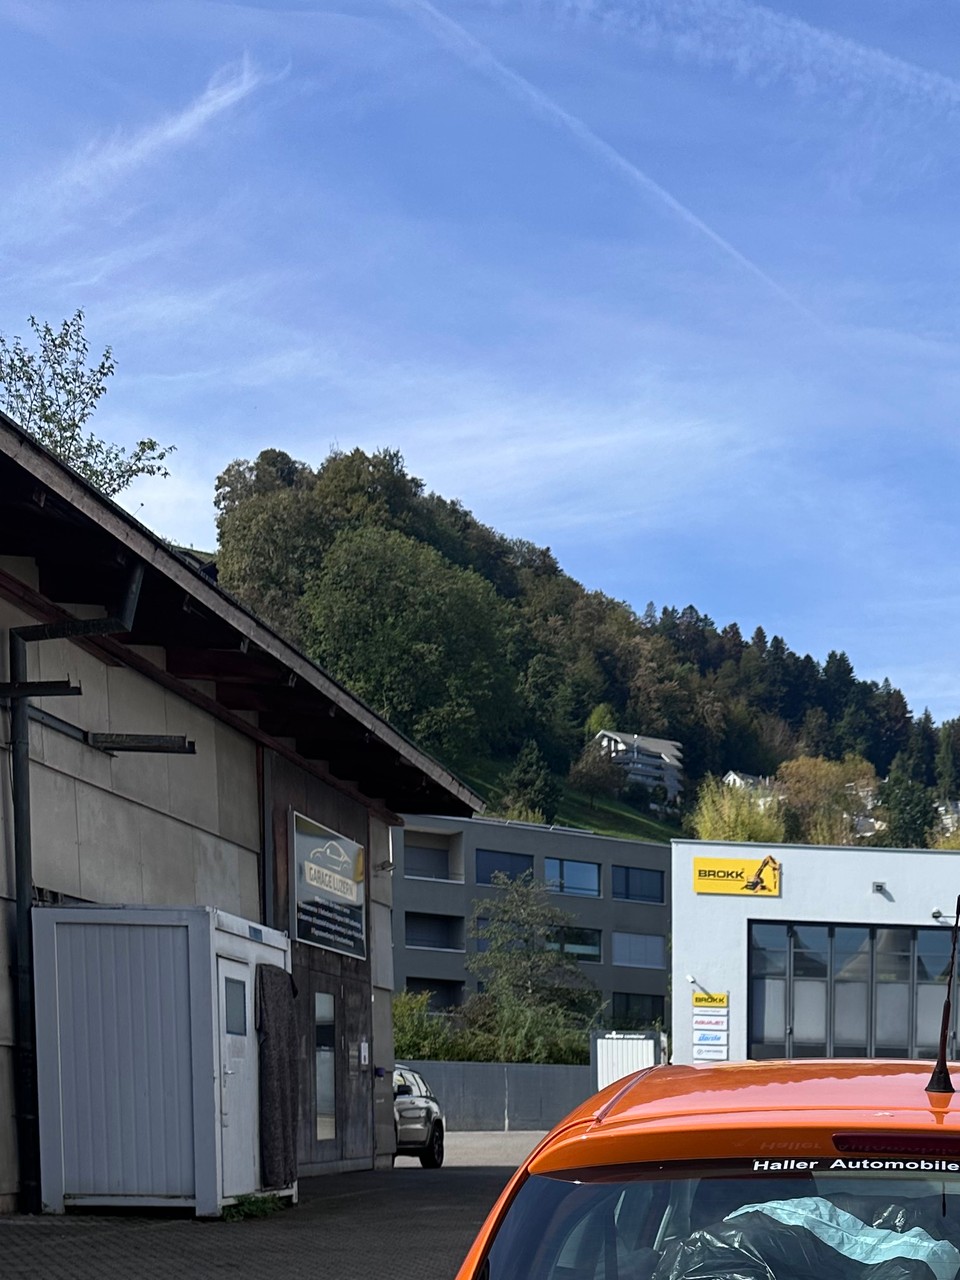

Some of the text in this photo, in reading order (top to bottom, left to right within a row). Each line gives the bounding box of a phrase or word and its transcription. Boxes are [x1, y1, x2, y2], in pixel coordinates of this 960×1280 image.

[698, 869, 745, 879] BROKK
[309, 866, 354, 898] GARAGE LUZERN
[694, 996, 725, 1004] BROKK
[753, 1159, 818, 1171] Haller
[829, 1158, 960, 1171] Automobile
